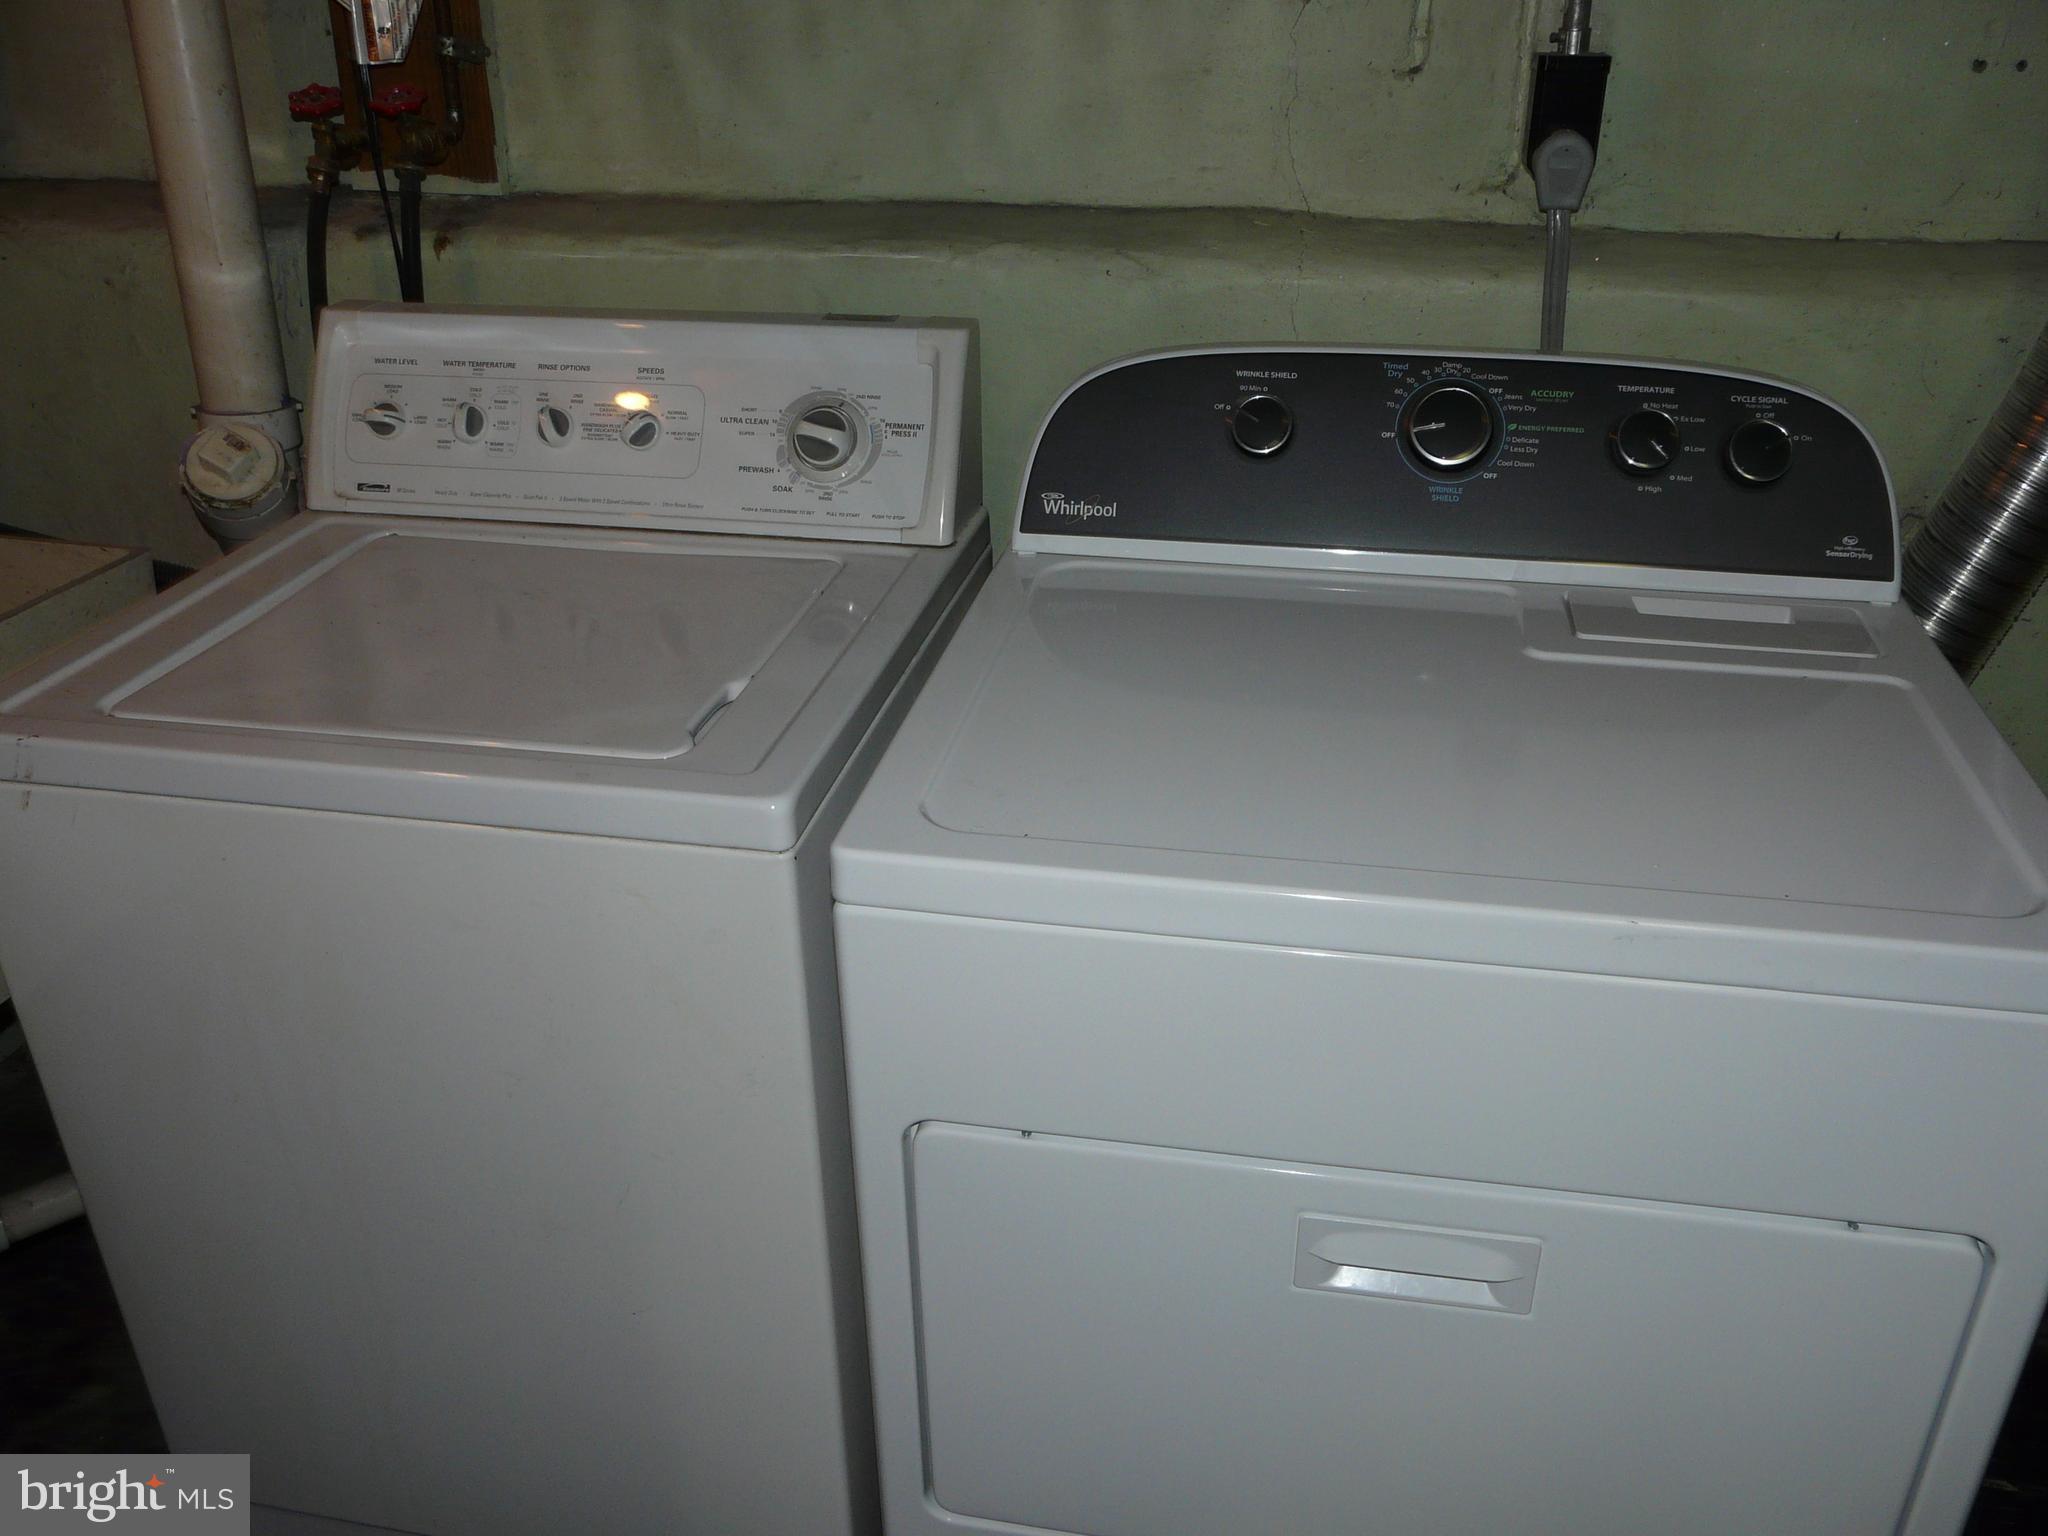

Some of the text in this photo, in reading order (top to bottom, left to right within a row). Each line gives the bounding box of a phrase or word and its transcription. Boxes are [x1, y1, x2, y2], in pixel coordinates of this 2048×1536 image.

[374, 357, 418, 366] WATER LEVEL
[442, 359, 517, 369] WATER TEMPERATURE
[1383, 361, 1408, 370] Timed
[1442, 361, 1462, 370] Damp
[538, 363, 592, 373] RINSE OPTIONS
[637, 367, 665, 375] SPEEDS
[1446, 368, 1457, 376] Dry
[1236, 369, 1298, 379] WRINKLE SHIELD
[1387, 370, 1403, 379] Dry
[1530, 389, 1575, 398] ACCUDRY
[1617, 384, 1676, 394] TEMPERATURE
[1730, 395, 1789, 405] CYCLE SIGNAL
[1508, 404, 1537, 413] Very Dry
[719, 416, 743, 424] ULTRA
[744, 417, 770, 425] CLEAN
[885, 422, 925, 431] PERMANENT
[1547, 426, 1584, 434] PREFERRED
[890, 430, 911, 438] PRESS
[1511, 436, 1540, 444] Delicate
[1526, 446, 1538, 455] Dry
[1497, 459, 1535, 468] Cool Down
[738, 465, 774, 474] PREWASH
[1482, 472, 1498, 480] OFF
[772, 484, 793, 493] SOAK
[1428, 486, 1464, 494] WRINKLE
[1645, 485, 1662, 493] High
[1431, 494, 1460, 502] SHIELD
[1043, 499, 1117, 520] Whirlpool
[1825, 550, 1873, 561] SensorDrying
